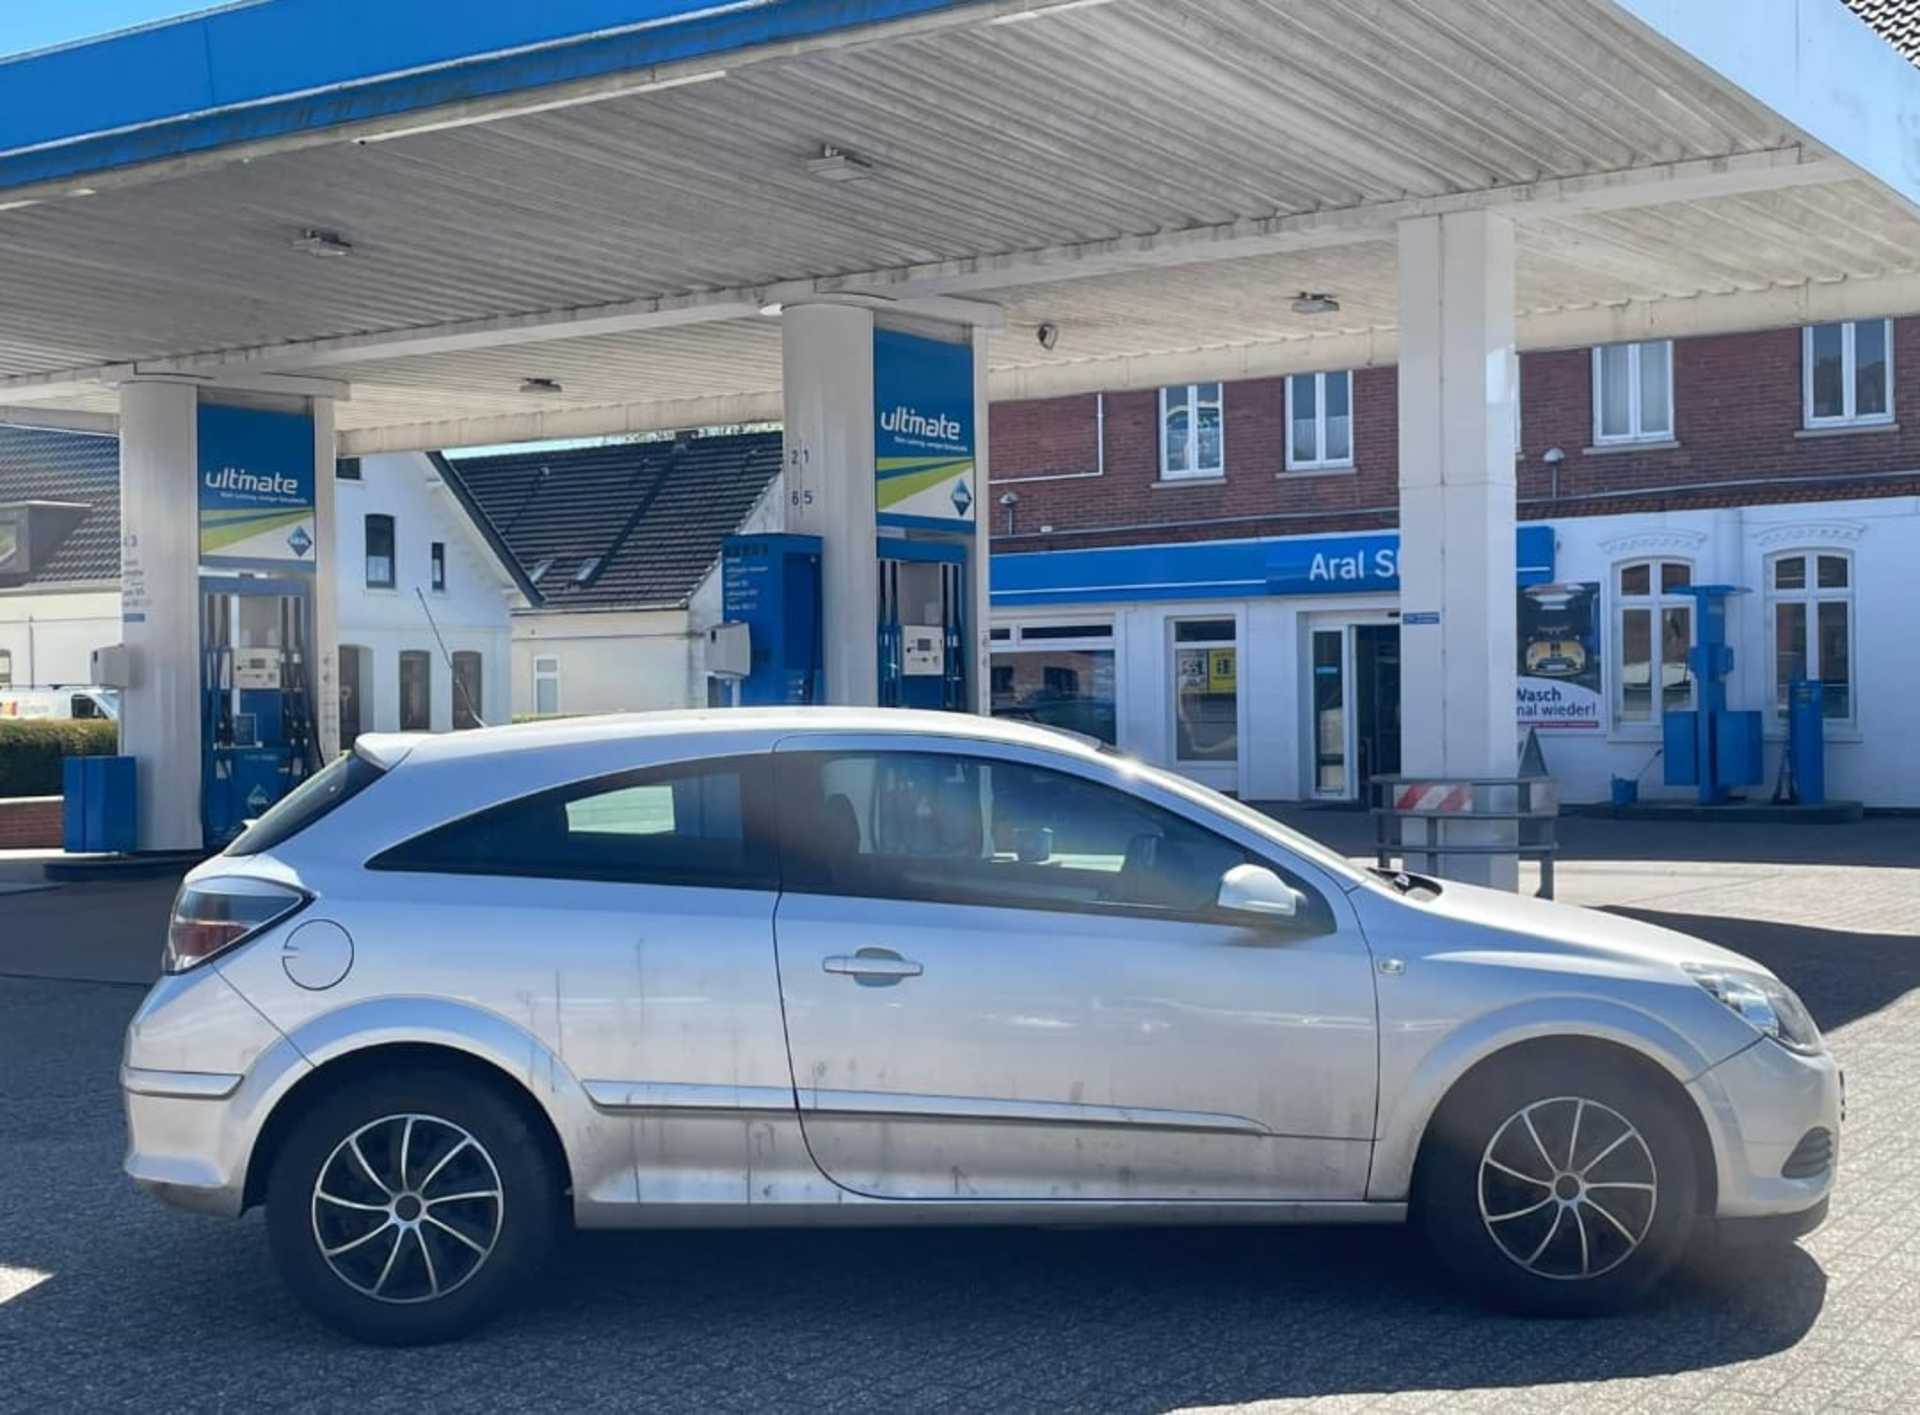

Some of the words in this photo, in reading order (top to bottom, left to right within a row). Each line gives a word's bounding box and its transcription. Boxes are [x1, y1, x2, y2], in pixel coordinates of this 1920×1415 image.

[881, 405, 961, 441] ultimate
[791, 449, 799, 465] 2
[205, 467, 299, 495] ultimate
[804, 490, 813, 505] 5
[1309, 549, 1365, 581] Aral
[1375, 549, 1401, 578] S
[1541, 702, 1596, 717] wieder!
